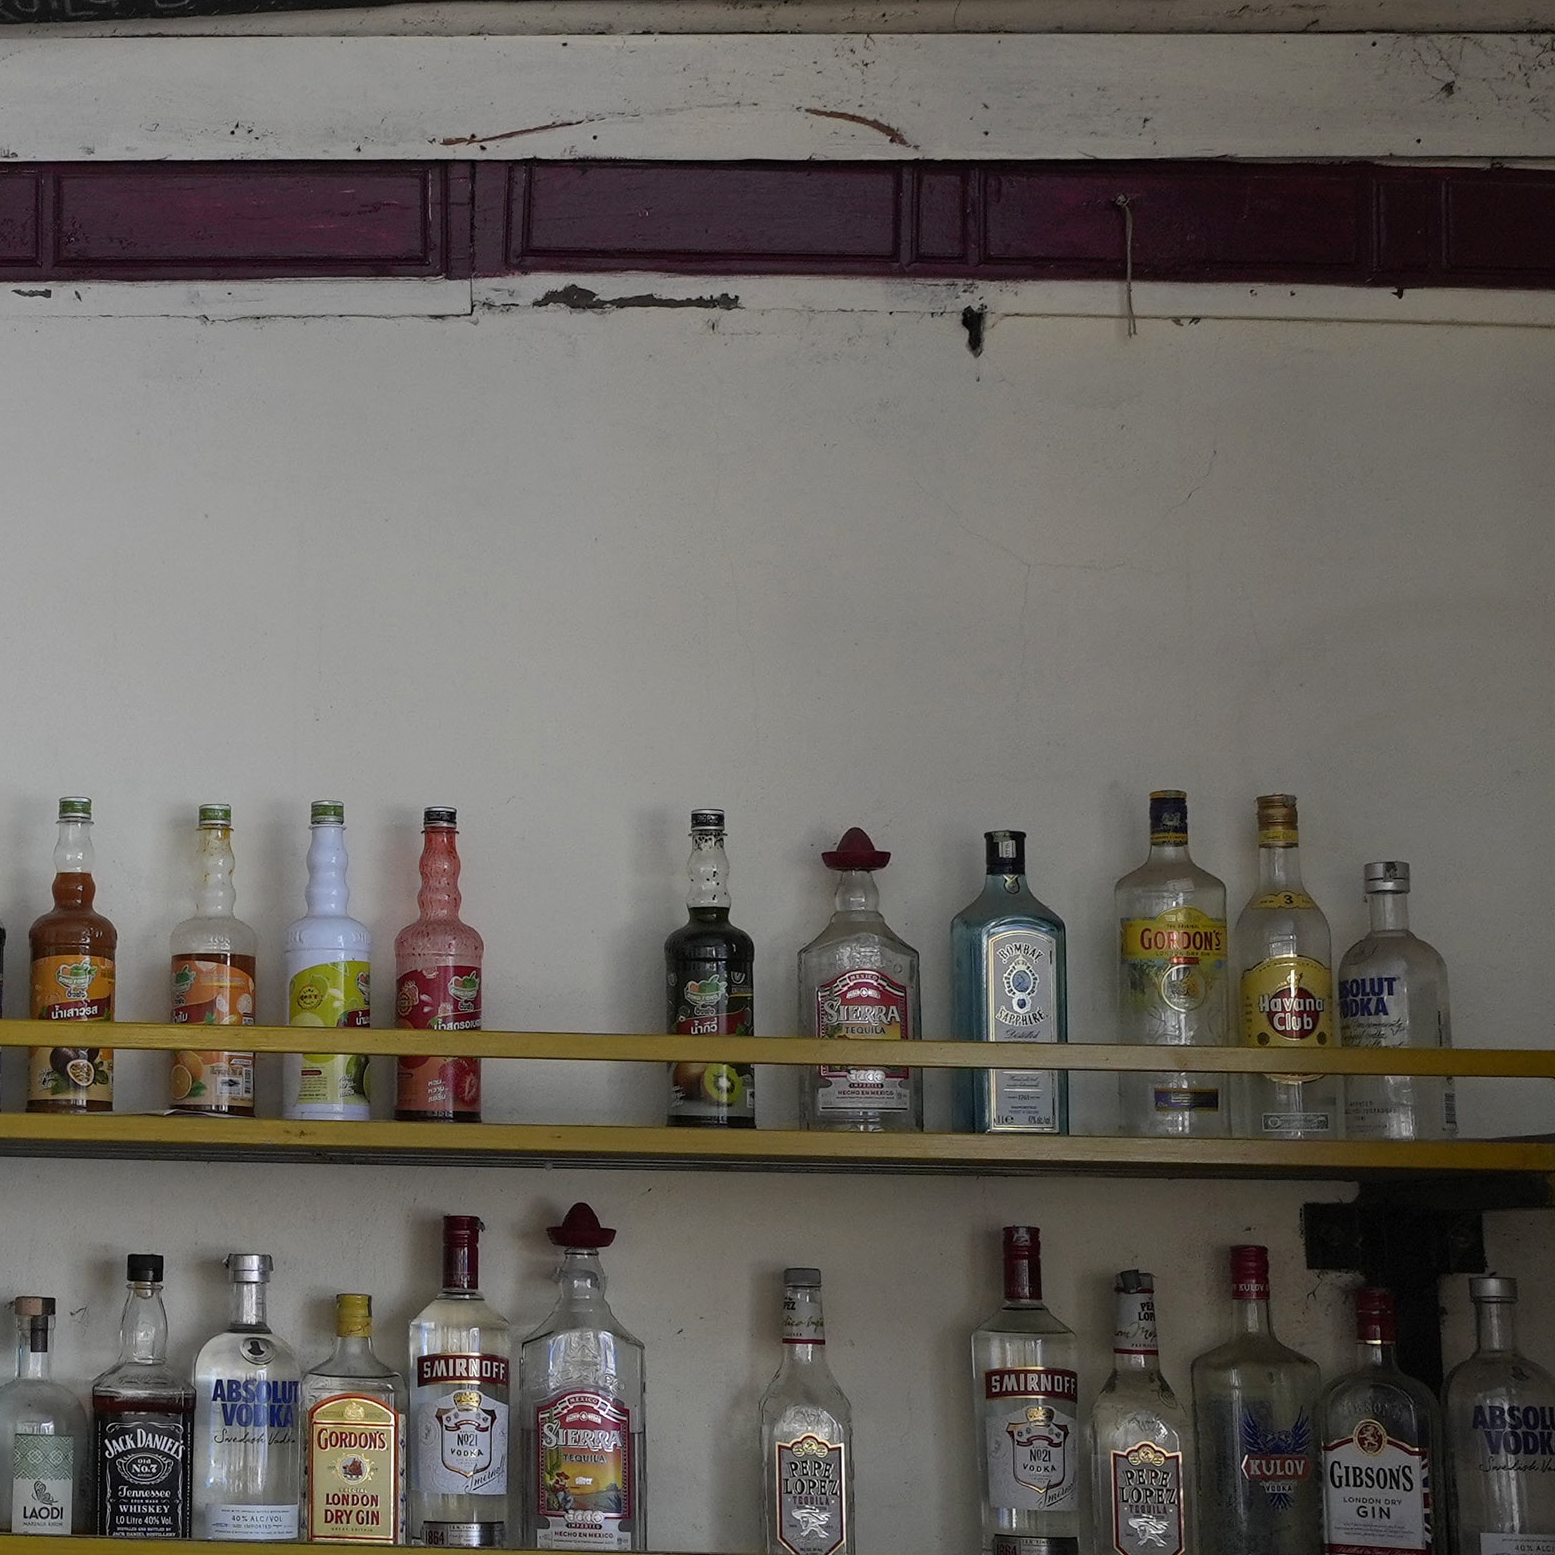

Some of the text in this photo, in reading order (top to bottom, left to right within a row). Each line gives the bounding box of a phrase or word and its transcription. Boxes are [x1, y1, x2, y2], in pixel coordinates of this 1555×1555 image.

[1283, 894, 1294, 906] 3
[1139, 927, 1223, 952] GORDON'S
[1257, 993, 1325, 1014] Havana
[844, 1025, 886, 1036] TEQUILA
[1271, 1012, 1314, 1032] Club
[423, 1358, 506, 1379] SMIRNOFF
[211, 1379, 300, 1403] ABSOLUT
[990, 1372, 1077, 1395] SMIRNOFF
[221, 1403, 295, 1428] VODKA
[317, 1428, 389, 1452] GORDON'S
[543, 1421, 623, 1452] SIERRA
[103, 1434, 135, 1460] JACK
[449, 1448, 485, 1458] VODKA
[562, 1452, 607, 1464] TEQUILA
[1022, 1462, 1057, 1473] VODKA
[1249, 1457, 1307, 1477] KULOV
[787, 1459, 835, 1480] PEPE
[1123, 1468, 1171, 1488] PEPE
[1329, 1459, 1414, 1493] GIBSON'S
[117, 1484, 173, 1499] Tennessee
[782, 1477, 841, 1497] LOPEZ
[1118, 1485, 1178, 1505] LOPEZ
[1264, 1482, 1294, 1493] VODKA
[118, 1504, 171, 1515] WHISKEY
[325, 1493, 380, 1508] LONDON
[792, 1495, 831, 1506] TEQUILA
[1342, 1496, 1403, 1506] LONDON DRY
[22, 1505, 64, 1520] LAODI
[324, 1509, 381, 1527] DRY GIN
[1356, 1505, 1392, 1520] GIN
